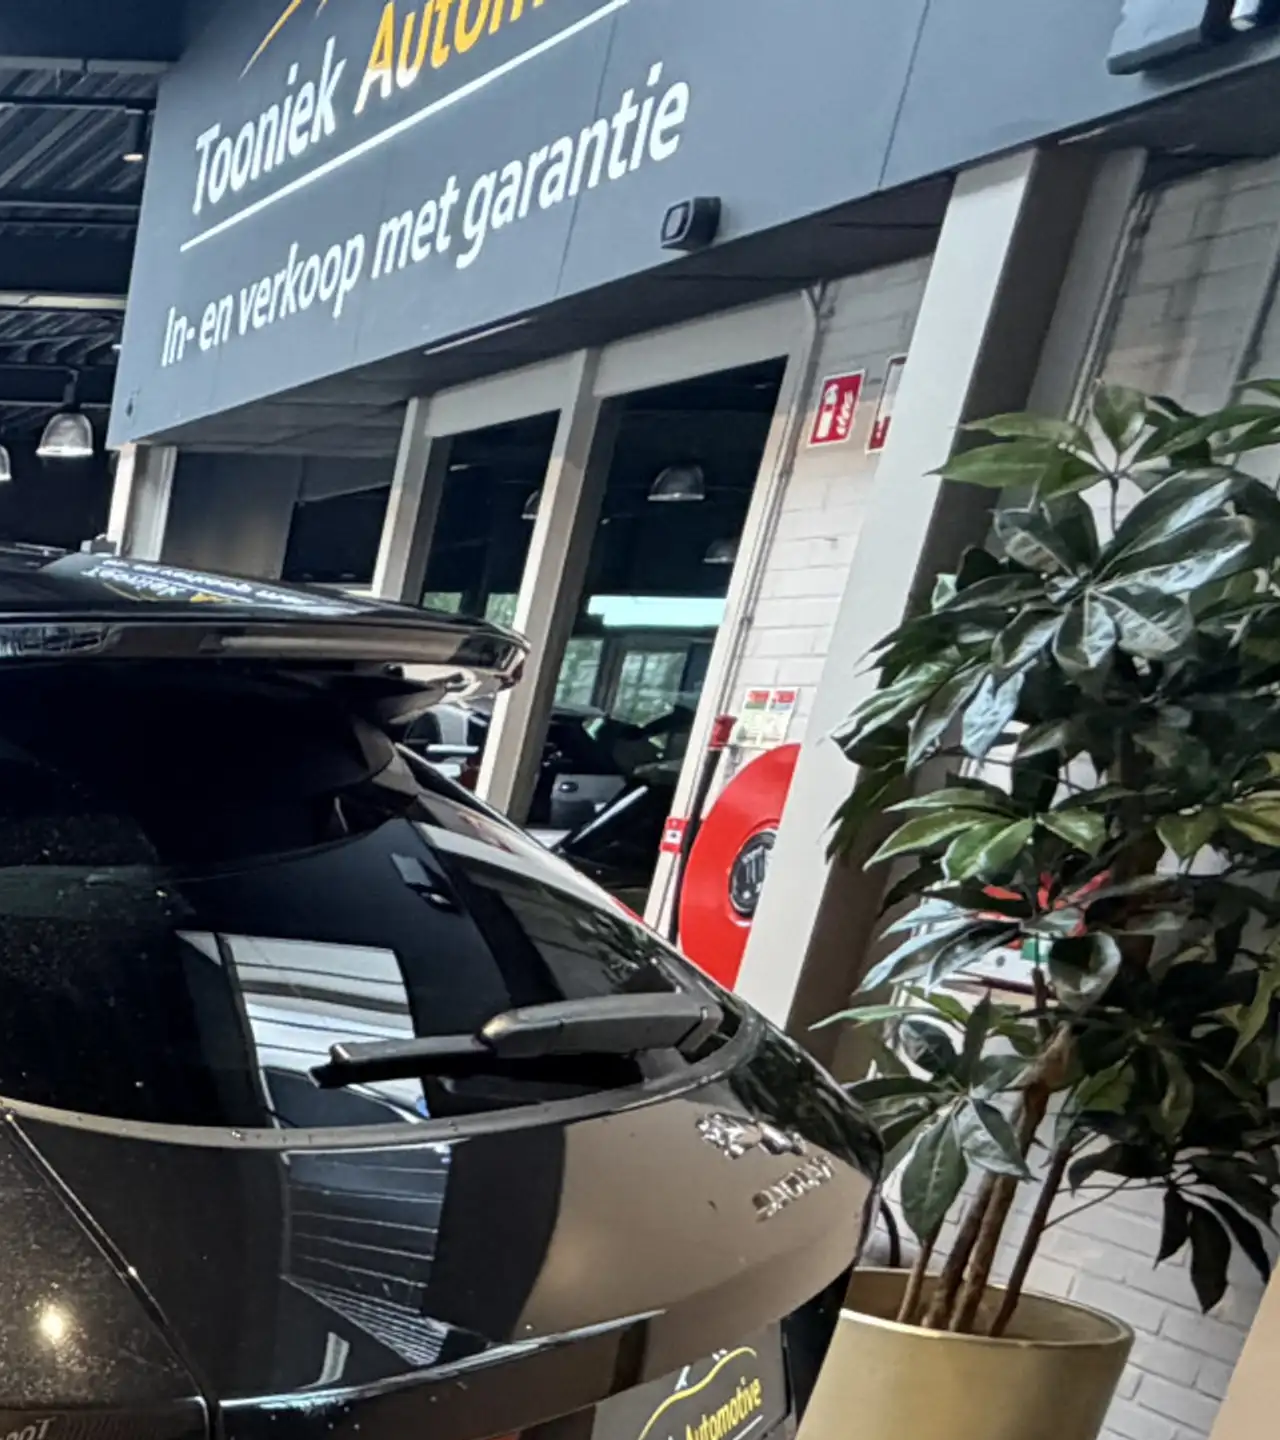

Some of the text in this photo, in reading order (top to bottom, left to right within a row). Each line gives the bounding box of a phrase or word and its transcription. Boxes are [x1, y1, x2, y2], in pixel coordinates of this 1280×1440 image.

[161, 61, 690, 367] In- en verkoop met garantie
[193, 36, 346, 215] Tooniek
